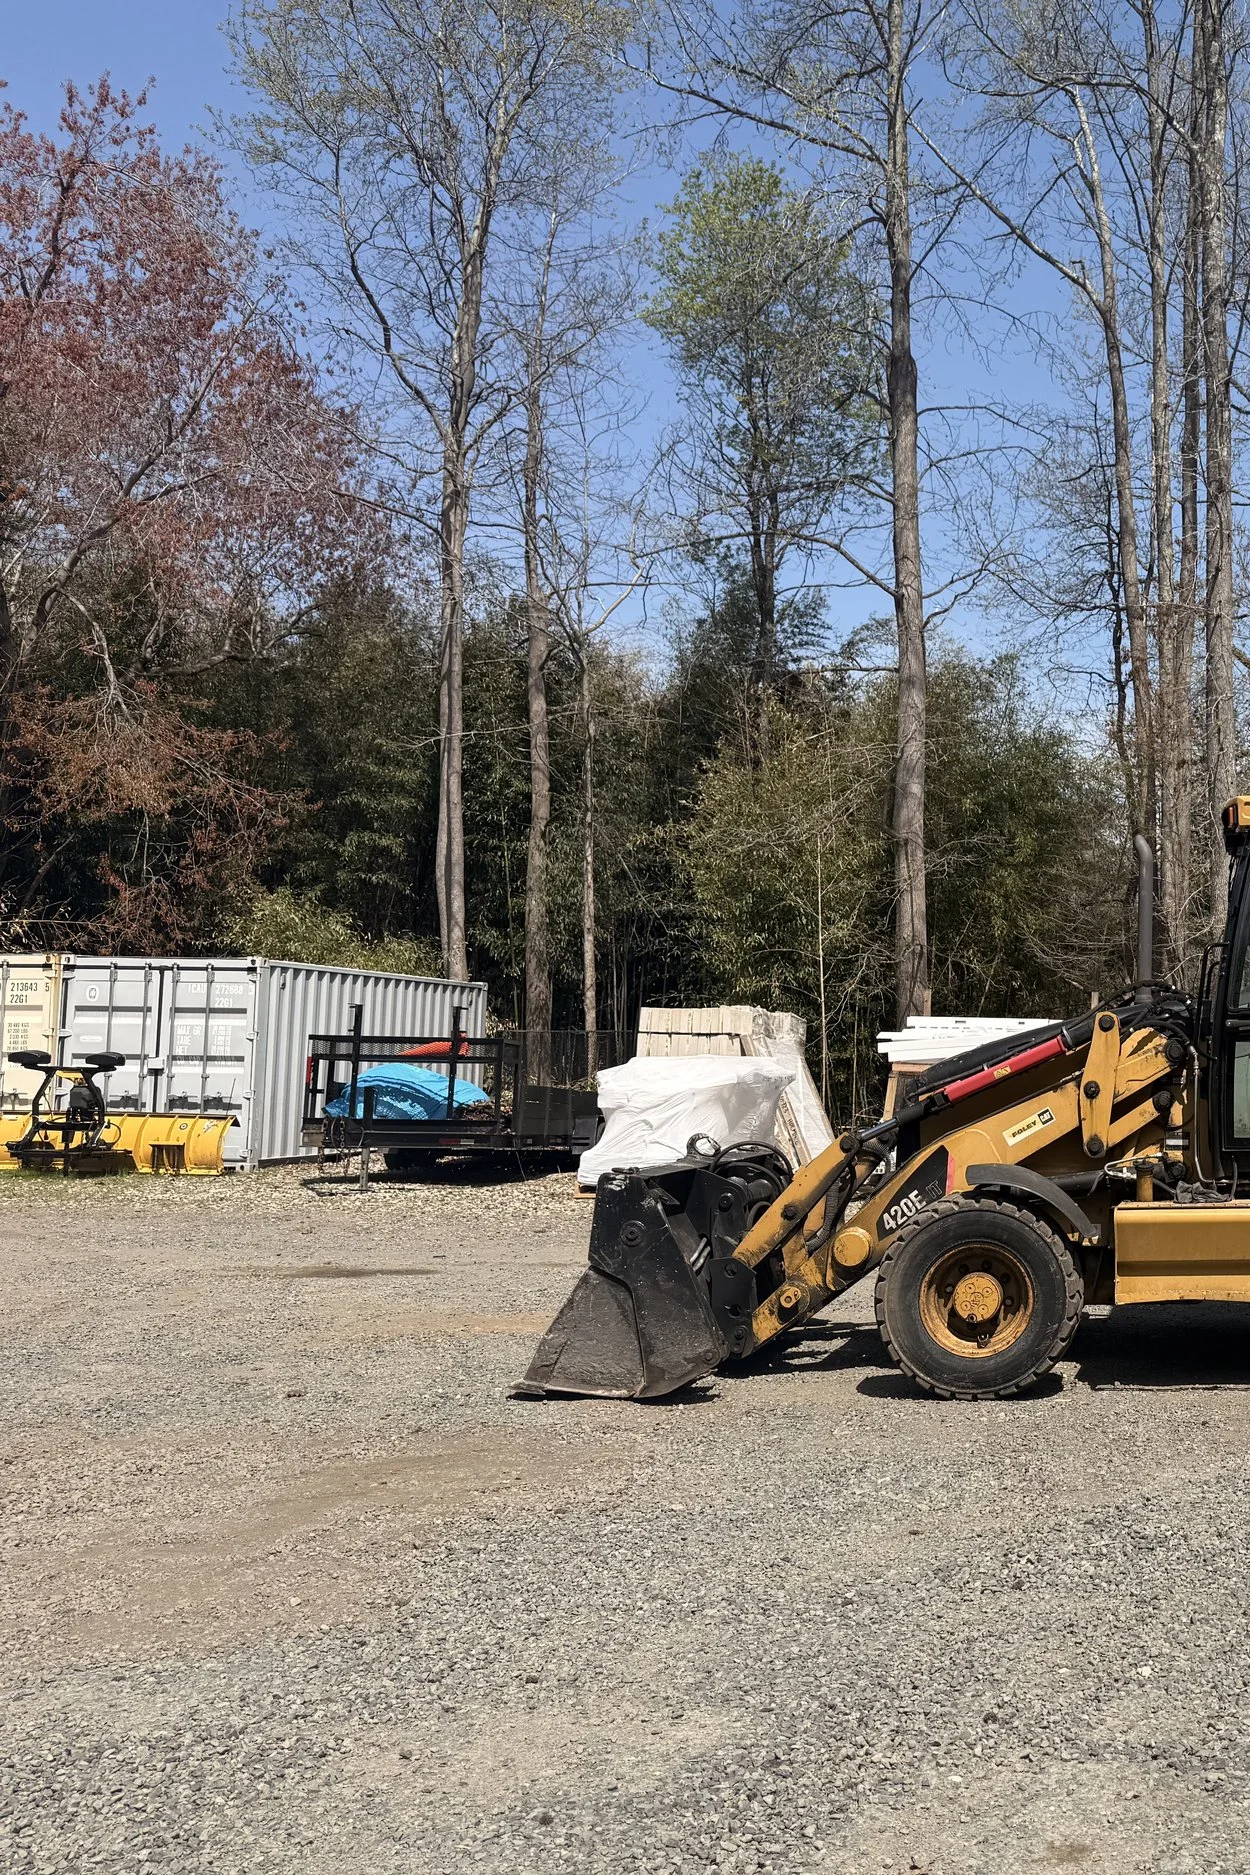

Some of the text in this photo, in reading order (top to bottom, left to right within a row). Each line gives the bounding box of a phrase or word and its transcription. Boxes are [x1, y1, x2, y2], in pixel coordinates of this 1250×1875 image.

[10, 982, 50, 992] 213643 5
[10, 994, 28, 1004] 22G1
[1011, 1119, 1037, 1138] FOLEY
[883, 1180, 943, 1231] 420E IT
